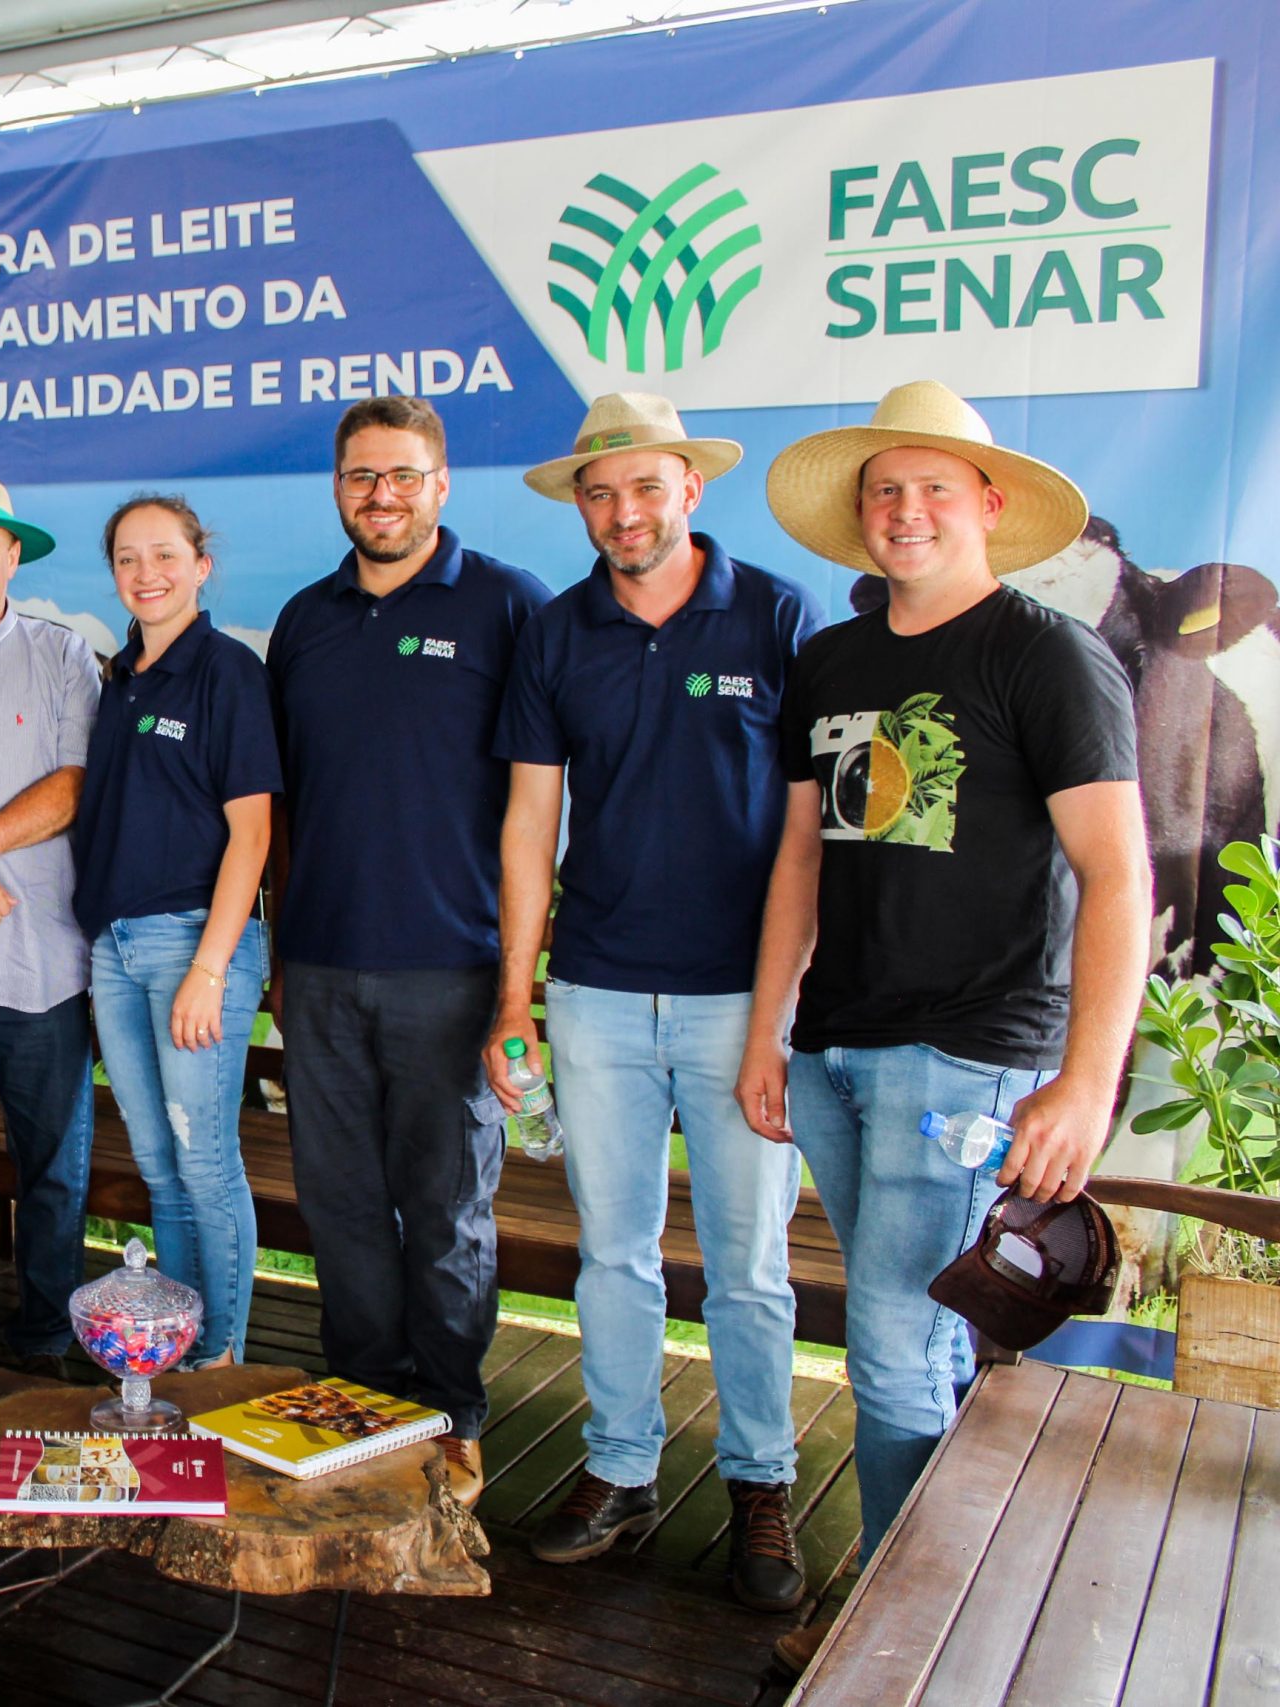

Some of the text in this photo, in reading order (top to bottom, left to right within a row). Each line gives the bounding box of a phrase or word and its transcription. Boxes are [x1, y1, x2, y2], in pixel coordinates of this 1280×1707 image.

[828, 138, 1141, 241] FAESC
[68, 217, 135, 266] DE
[151, 197, 296, 258] LEITE
[825, 243, 1166, 340] SENAR
[263, 275, 347, 326] DA
[250, 361, 282, 406] E
[300, 346, 514, 403] RENDA
[424, 638, 456, 650] FAESC
[421, 646, 455, 659] SENAR
[718, 675, 753, 687] FAESC
[717, 686, 753, 698] SENAR
[157, 717, 187, 732] FAESC
[154, 726, 186, 741] SENAR
